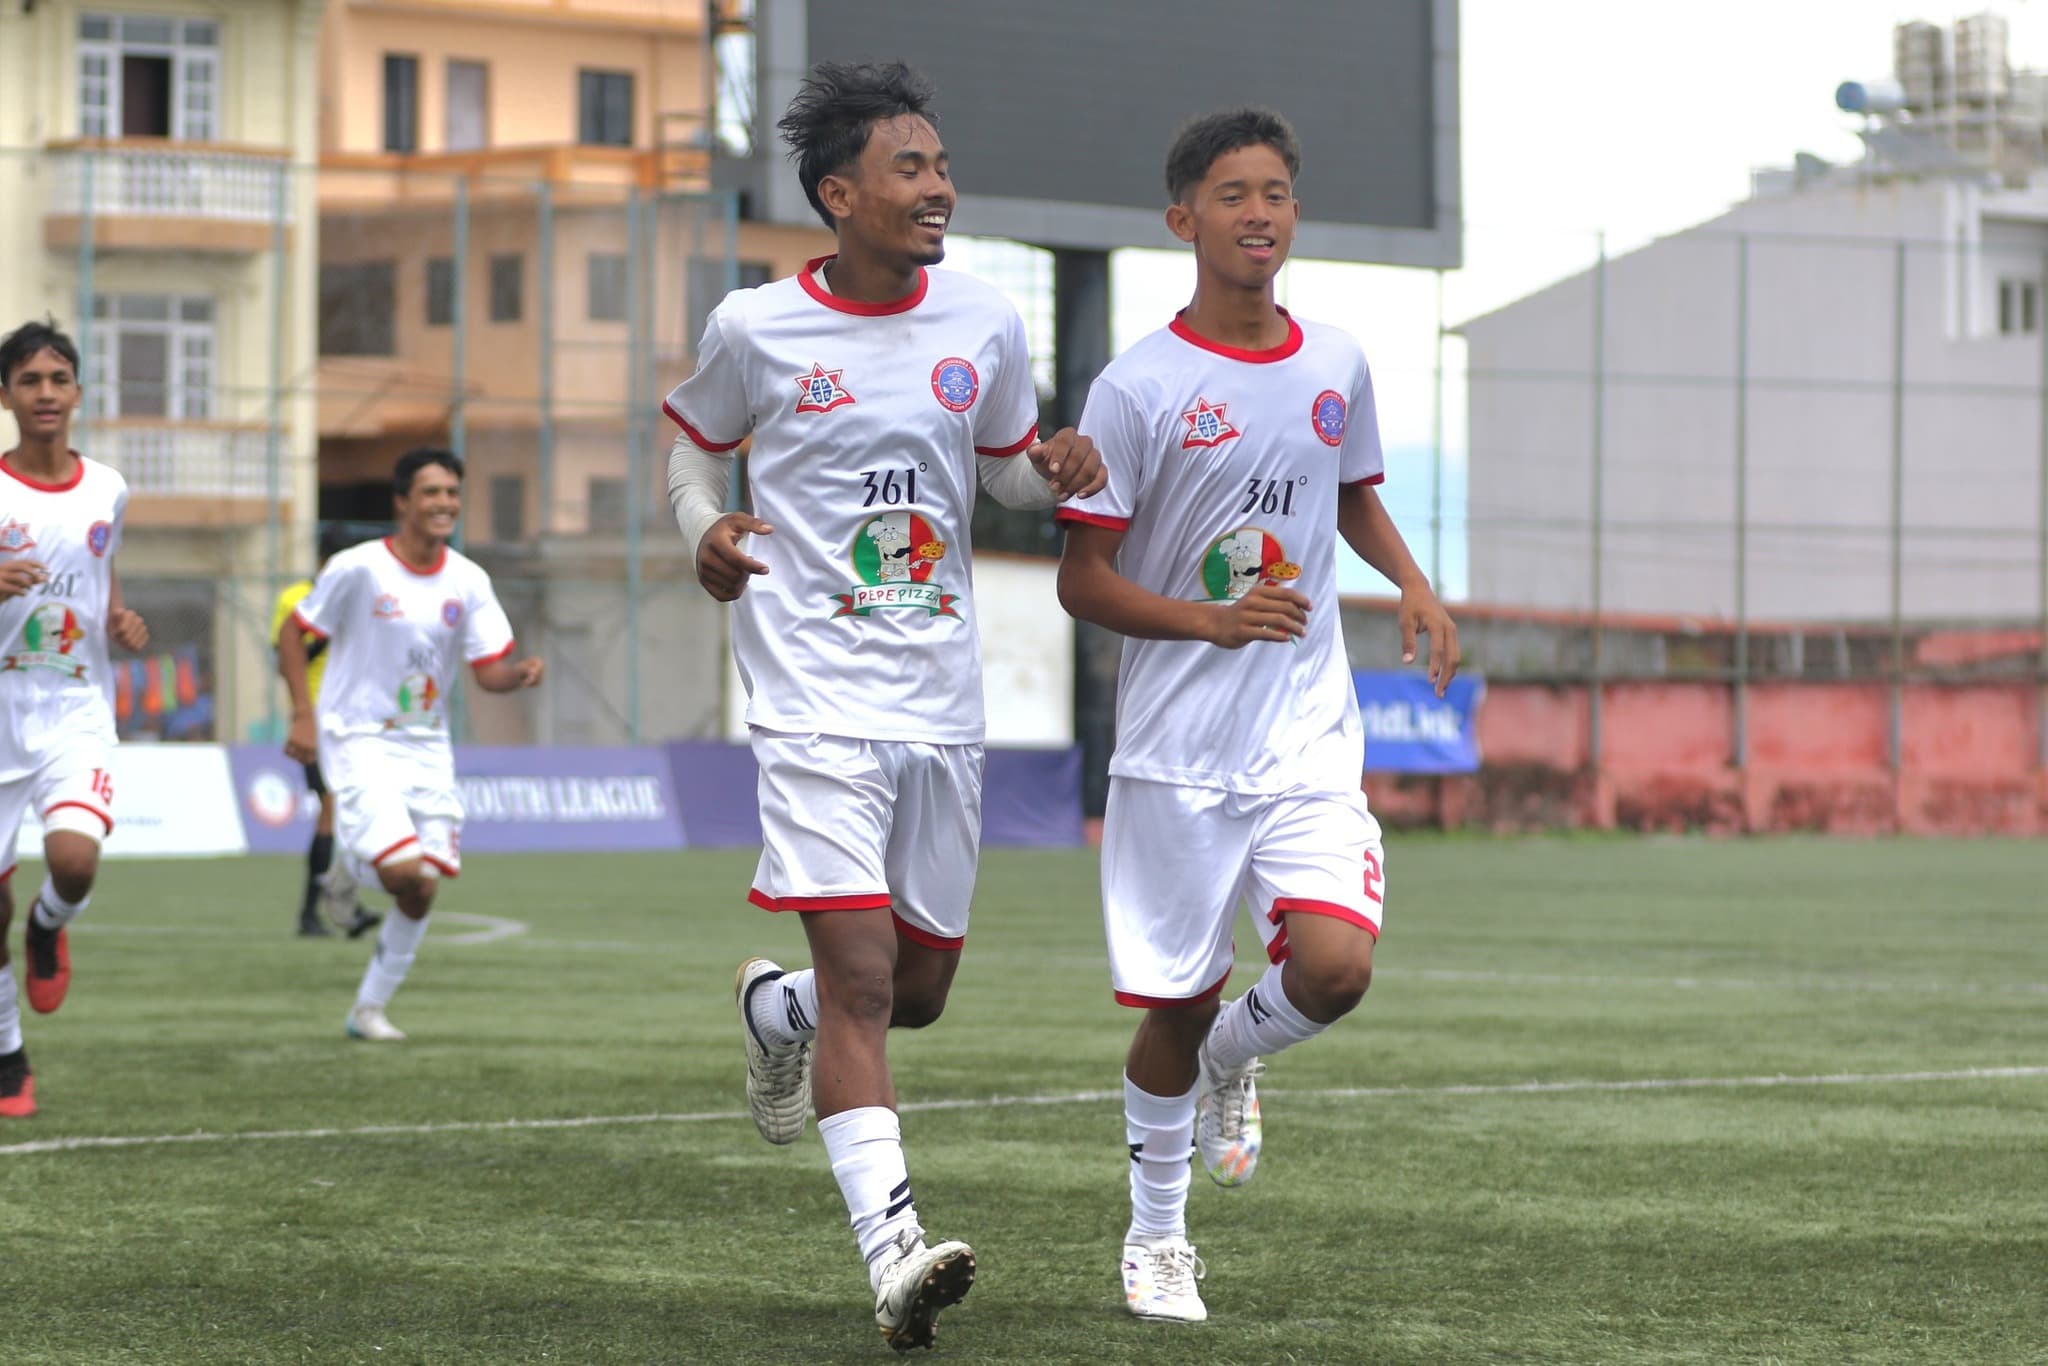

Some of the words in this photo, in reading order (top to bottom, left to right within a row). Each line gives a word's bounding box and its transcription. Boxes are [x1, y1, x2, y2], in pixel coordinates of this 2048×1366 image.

[91, 767, 113, 805] 16
[551, 775, 665, 821] LEAGUE
[1363, 849, 1381, 903] 2
